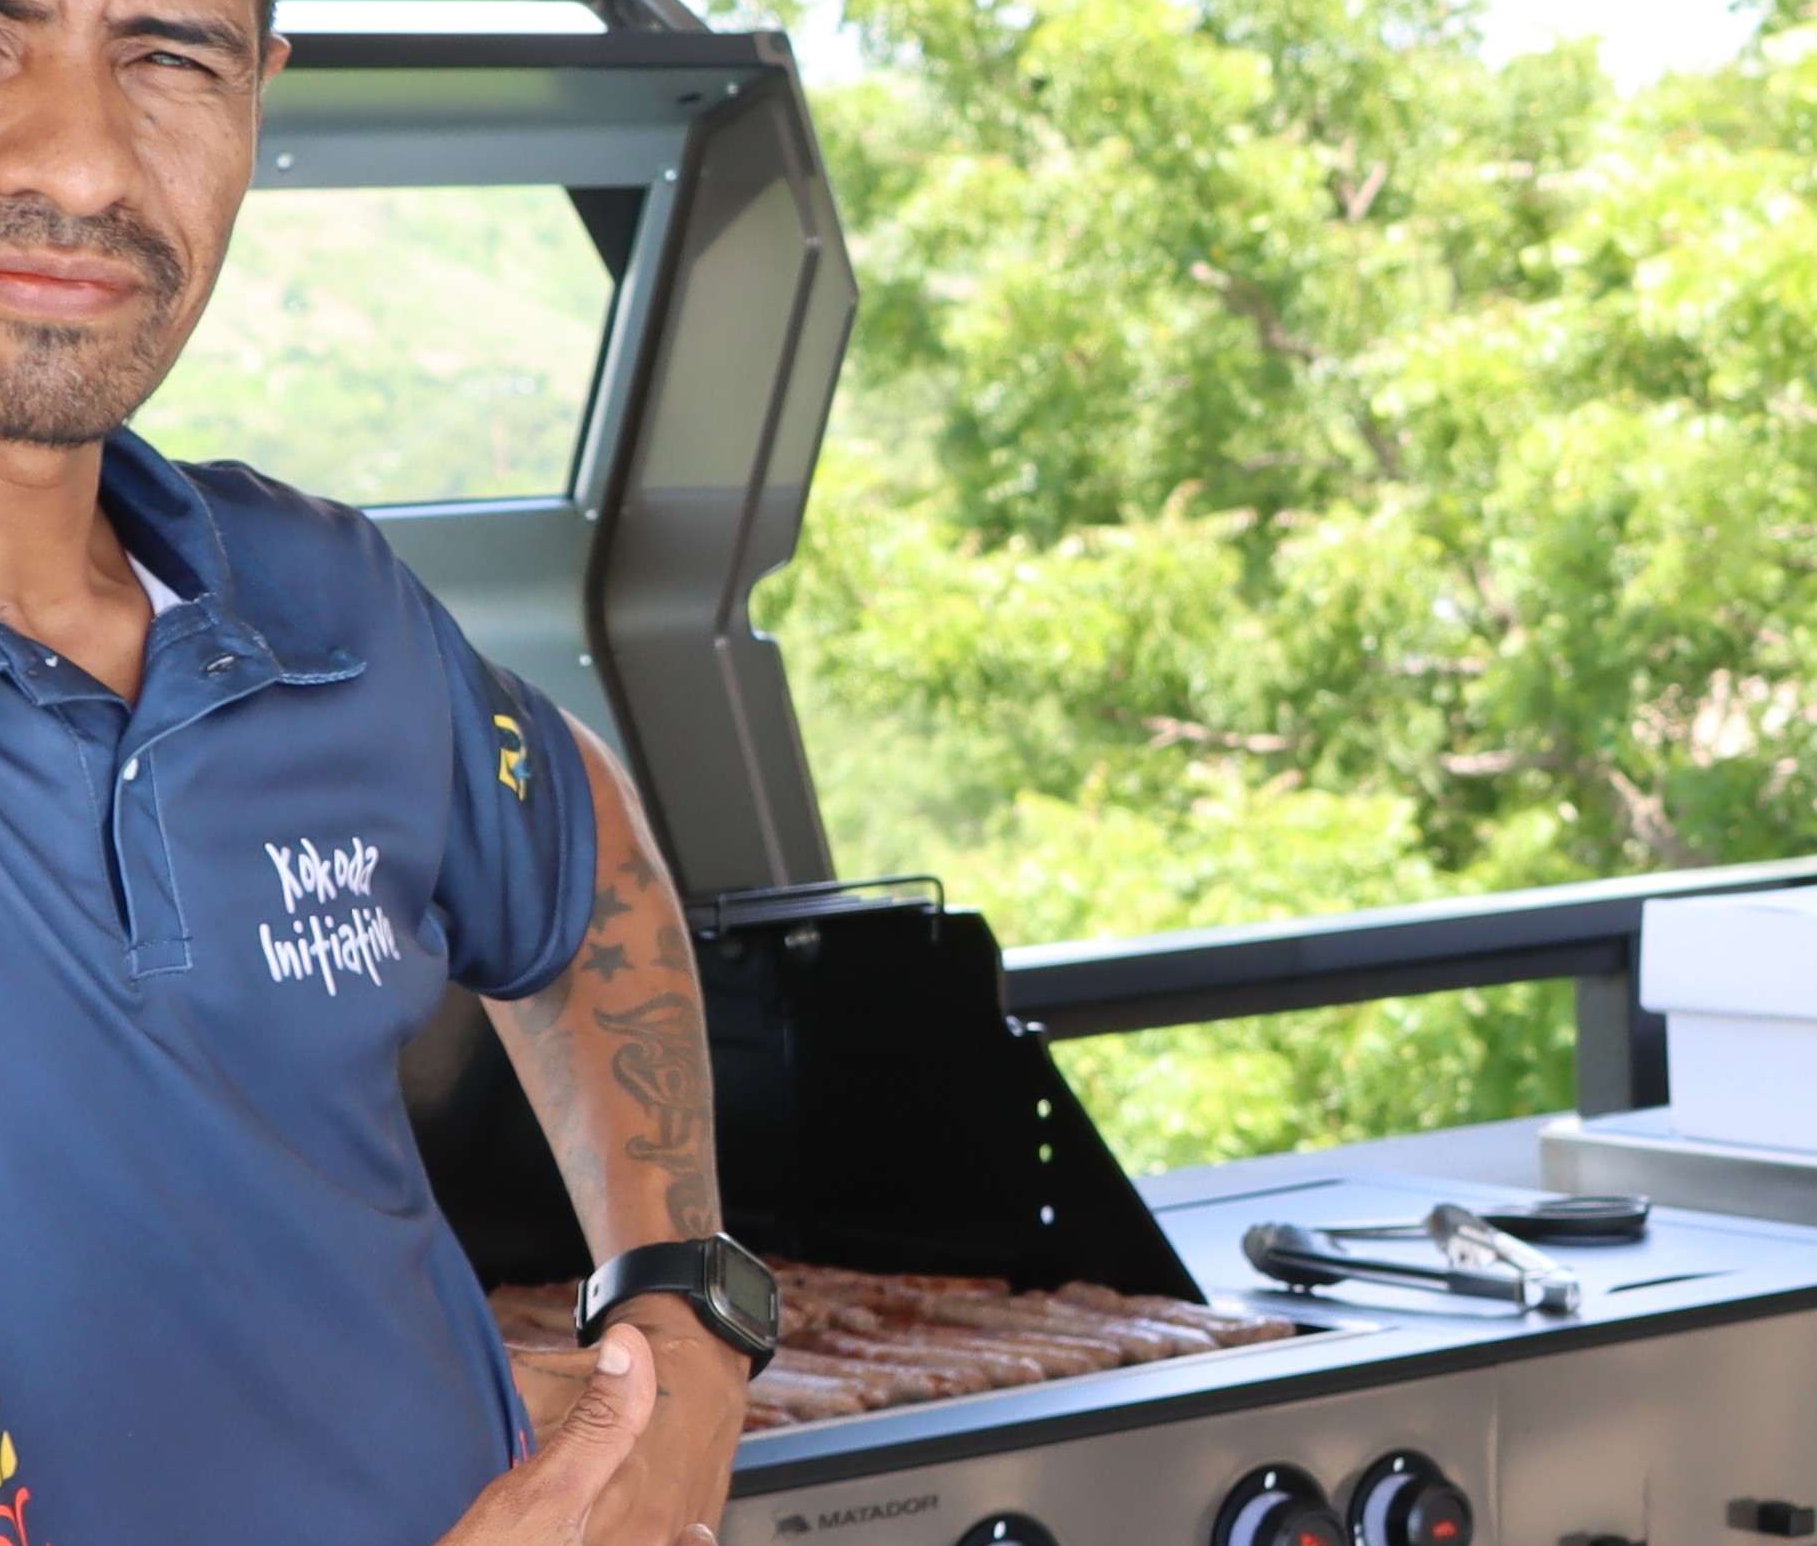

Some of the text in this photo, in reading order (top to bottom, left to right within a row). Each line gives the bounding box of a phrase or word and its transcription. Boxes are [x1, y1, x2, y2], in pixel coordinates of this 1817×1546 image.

[264, 836, 380, 914] Kokoda
[259, 905, 401, 997] Initiative
[817, 1493, 940, 1531] MATADOR
